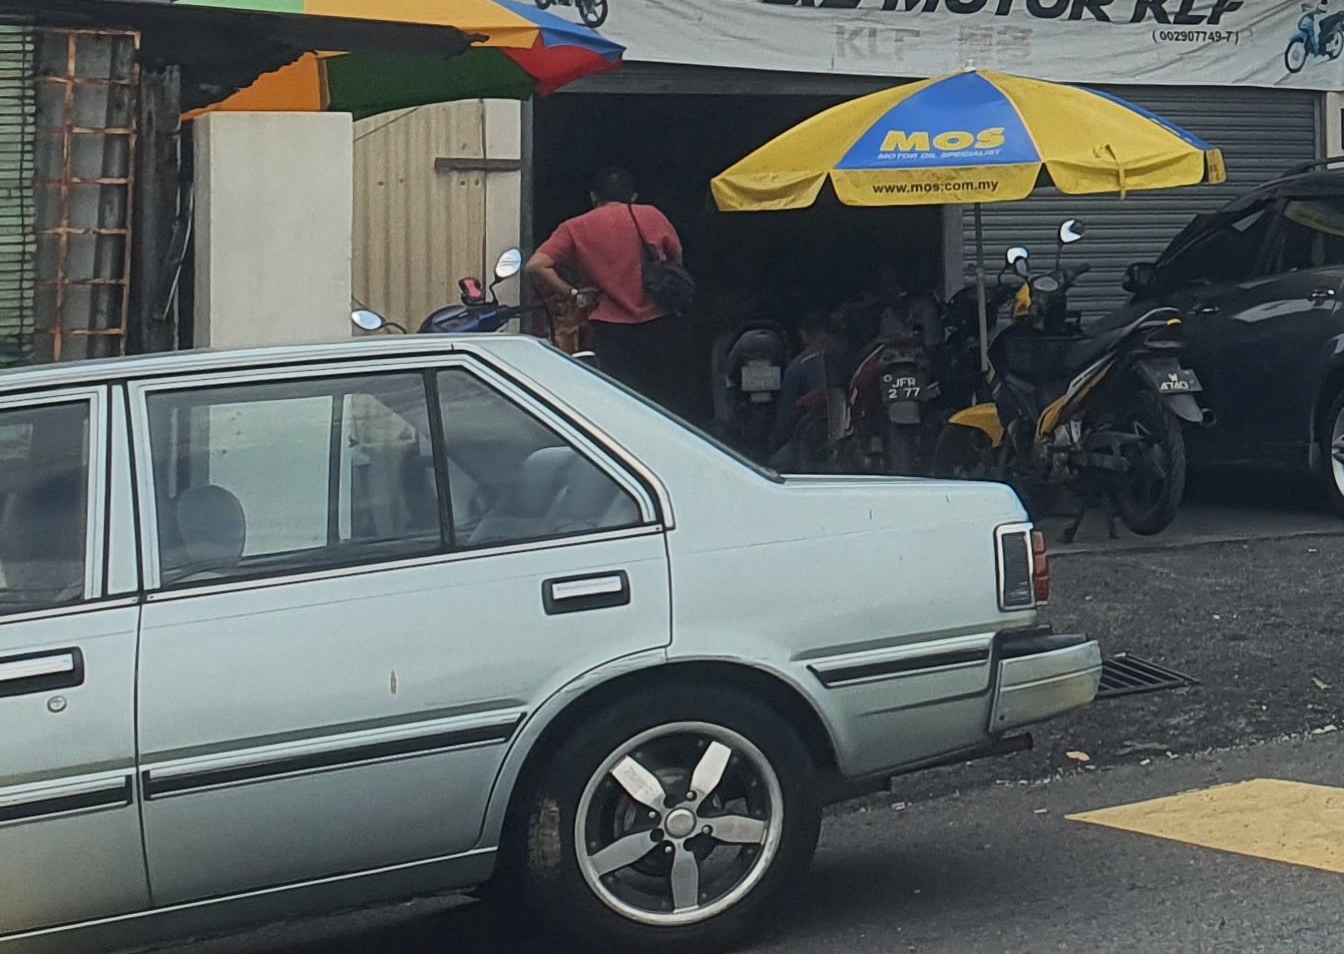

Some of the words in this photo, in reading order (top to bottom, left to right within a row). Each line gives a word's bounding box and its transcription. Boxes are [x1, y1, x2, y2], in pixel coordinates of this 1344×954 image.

[879, 127, 1005, 151] MOS
[877, 152, 918, 160] MOTOR
[940, 149, 1001, 158] SPECIALIST
[873, 181, 999, 193] www.mos.com.my
[892, 377, 916, 388] JFR
